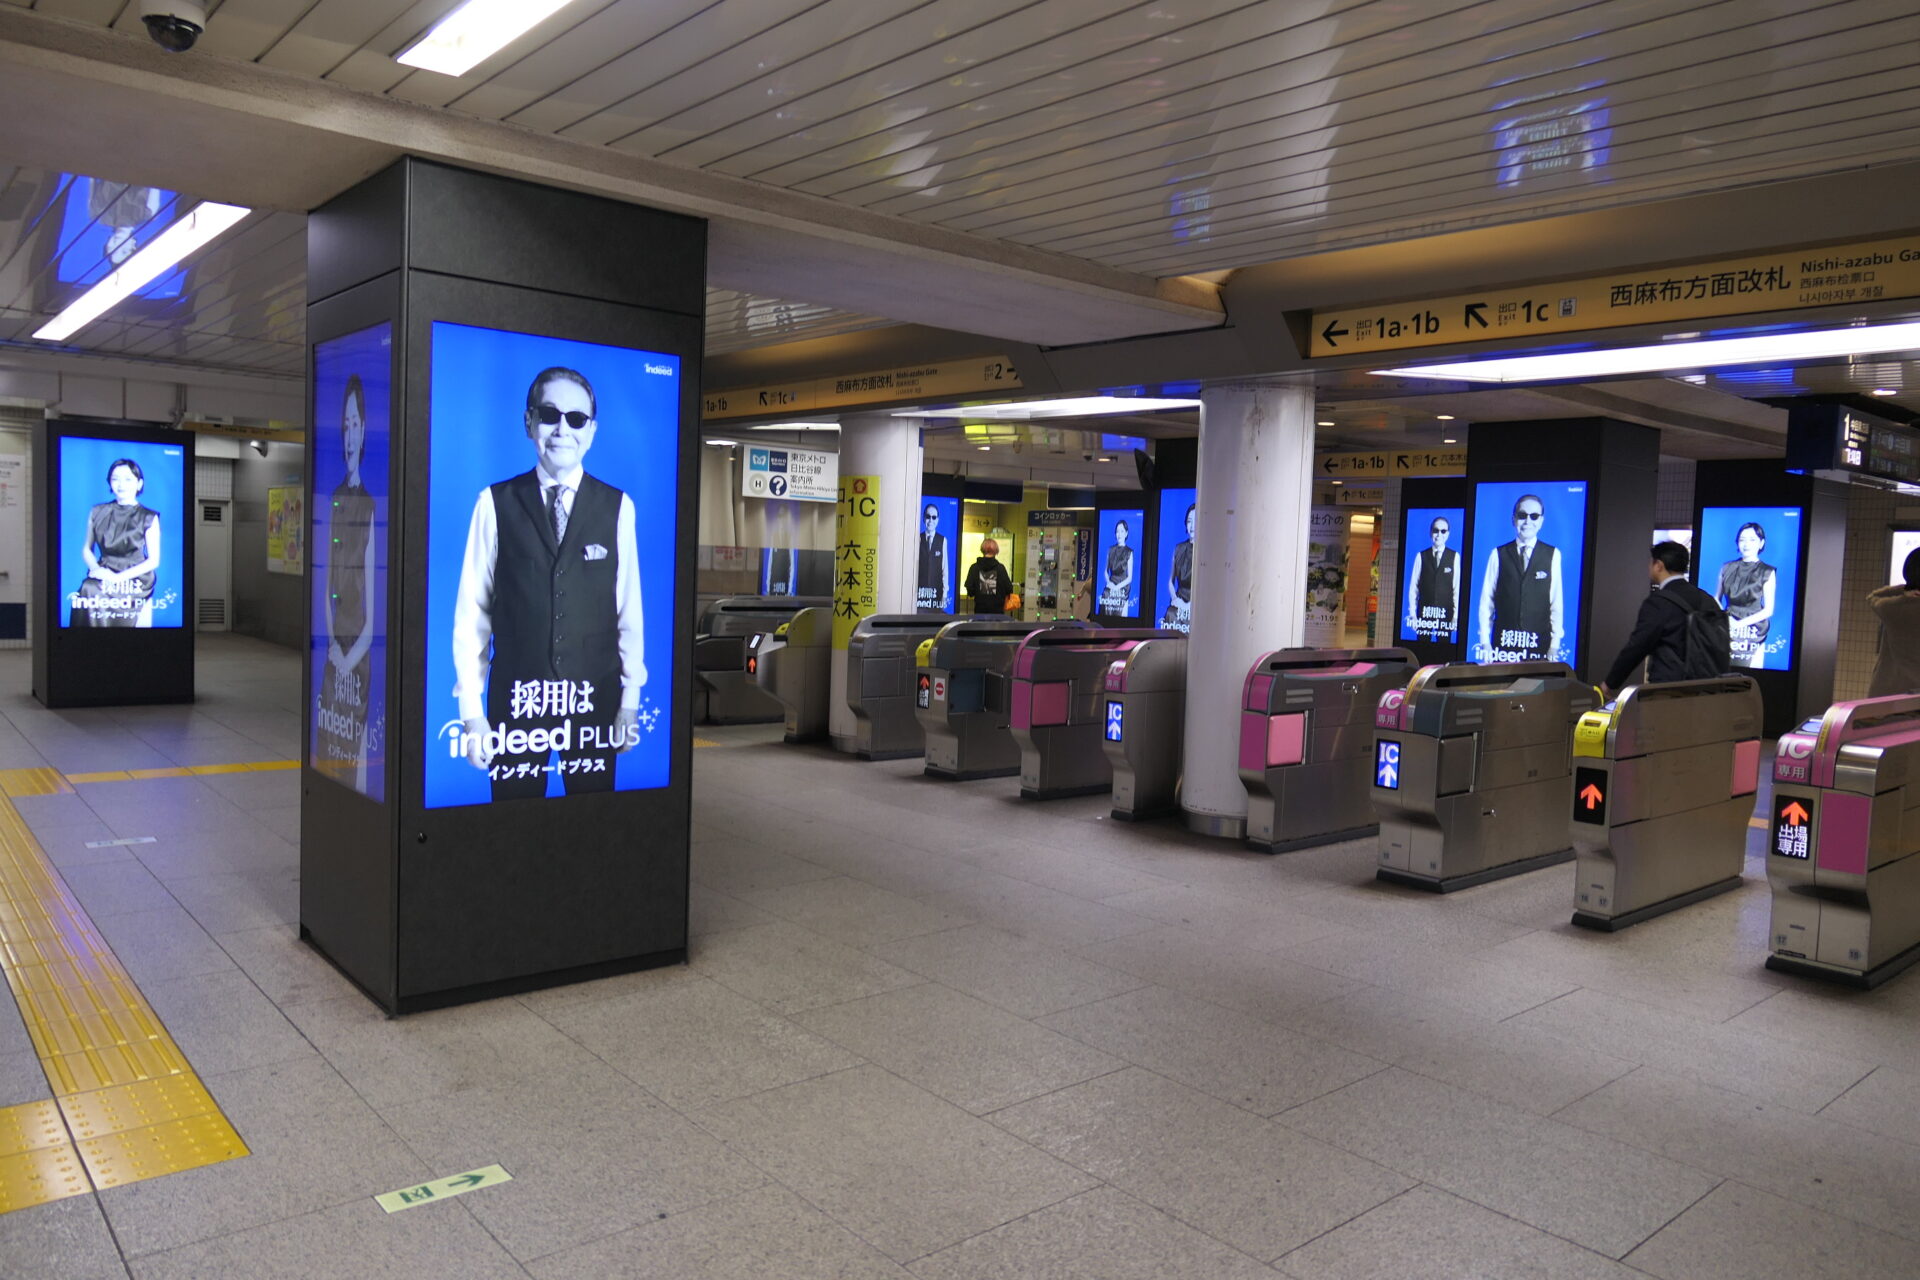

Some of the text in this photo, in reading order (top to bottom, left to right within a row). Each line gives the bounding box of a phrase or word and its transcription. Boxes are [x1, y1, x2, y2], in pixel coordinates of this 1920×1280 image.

[1801, 252, 1893, 273] Nishi-azabu
[1610, 265, 1791, 308] 西麻布方面改札
[1498, 302, 1517, 313] 出口
[1521, 300, 1549, 323] 1c
[1356, 319, 1372, 329] 出口
[1498, 312, 1517, 321] Exit
[1356, 329, 1372, 337] Exit
[994, 363, 1002, 380] 2
[836, 375, 893, 394] 西麻布方面改札
[778, 391, 787, 404] 1c
[791, 452, 826, 464] 東京メトロ
[1424, 454, 1437, 467] 1c
[790, 464, 821, 475] 日比谷線
[790, 475, 813, 486] 案内所
[847, 497, 876, 517] 1C
[1034, 512, 1071, 520] コインロッカー
[842, 540, 862, 620] 六本木
[71, 593, 132, 609] indeed
[1422, 605, 1446, 619] 採用は
[1405, 618, 1439, 630] indeed
[1500, 629, 1539, 648] 採用は
[1474, 646, 1527, 664] indeed
[1108, 660, 1126, 676] IC
[510, 679, 594, 719] 採用は
[1379, 692, 1403, 709] IC
[317, 697, 354, 741] indeed
[1108, 703, 1122, 720] IC
[1378, 714, 1396, 726] 専用
[446, 719, 641, 758] indeed PLUS
[1379, 743, 1399, 764] IC
[1778, 738, 1813, 759] IC
[488, 758, 606, 781] インディードプラス
[1778, 764, 1805, 778] 専用
[1778, 824, 1808, 841] 出場
[1777, 839, 1808, 857] 専用
